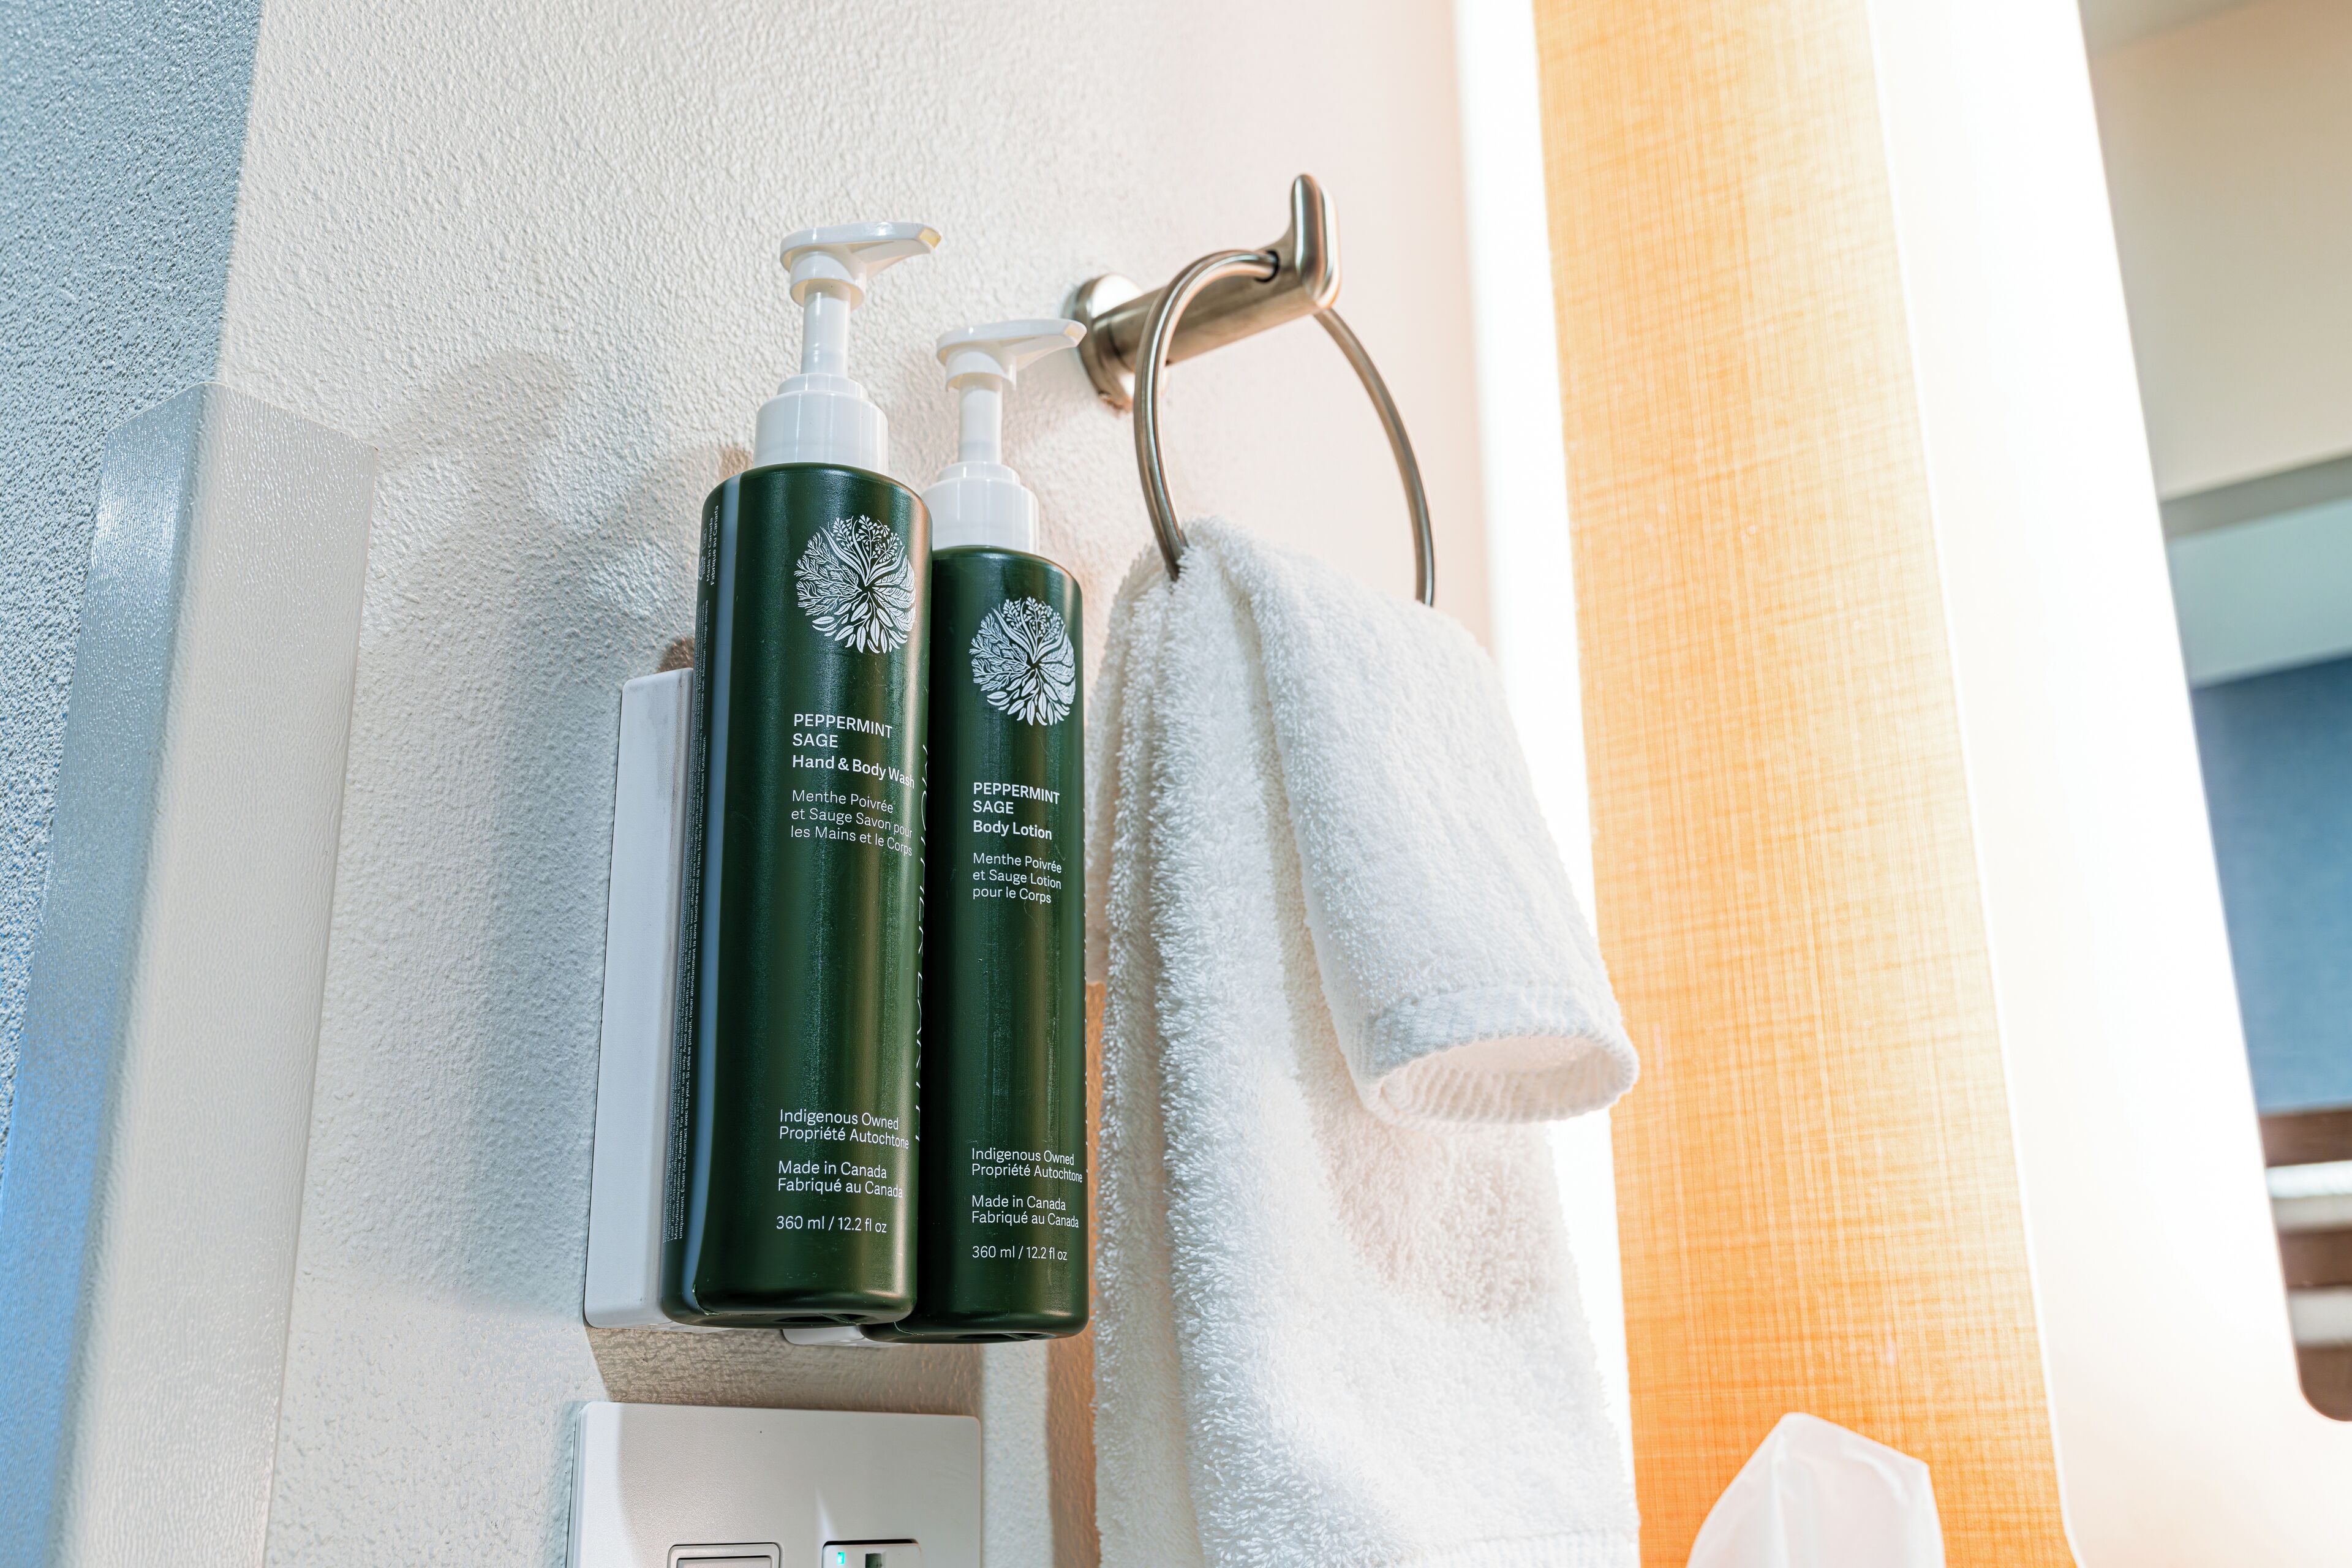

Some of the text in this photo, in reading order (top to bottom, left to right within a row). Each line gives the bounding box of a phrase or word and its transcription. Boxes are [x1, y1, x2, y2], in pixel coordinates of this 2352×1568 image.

[793, 714, 893, 739] PEPPERMINT
[793, 733, 839, 748] SAGE
[793, 755, 914, 790] Hand & Body Wash
[792, 790, 894, 814] Menthe Poivrée
[973, 782, 1060, 805] PEPPERMINT
[973, 800, 1014, 814] SAGE
[791, 808, 913, 838] et Sauge Savon pour
[973, 820, 1052, 840] Body Lotion
[791, 825, 912, 856] les Mains et le Corps
[973, 853, 1062, 873] Menthe Poivrée
[973, 869, 1061, 889] et Sauge Lotion
[973, 886, 1052, 905] pour le Corps
[780, 1109, 899, 1131] Indigenous Owned
[779, 1126, 909, 1150] Propriété Autochtone
[972, 1147, 1074, 1166] Indigenous Owned
[778, 1160, 887, 1178] Made in Canada
[972, 1164, 1083, 1183] Propriété Autochtone
[778, 1177, 903, 1198] Fabriqué au Canada
[972, 1194, 1066, 1211] Made in Canada
[776, 1215, 887, 1233] 360 ml / 12.2 fl oz
[972, 1210, 1079, 1228] Fabriqué au Canada
[972, 1246, 1068, 1261] 360 ml / 12.2 fl oz
